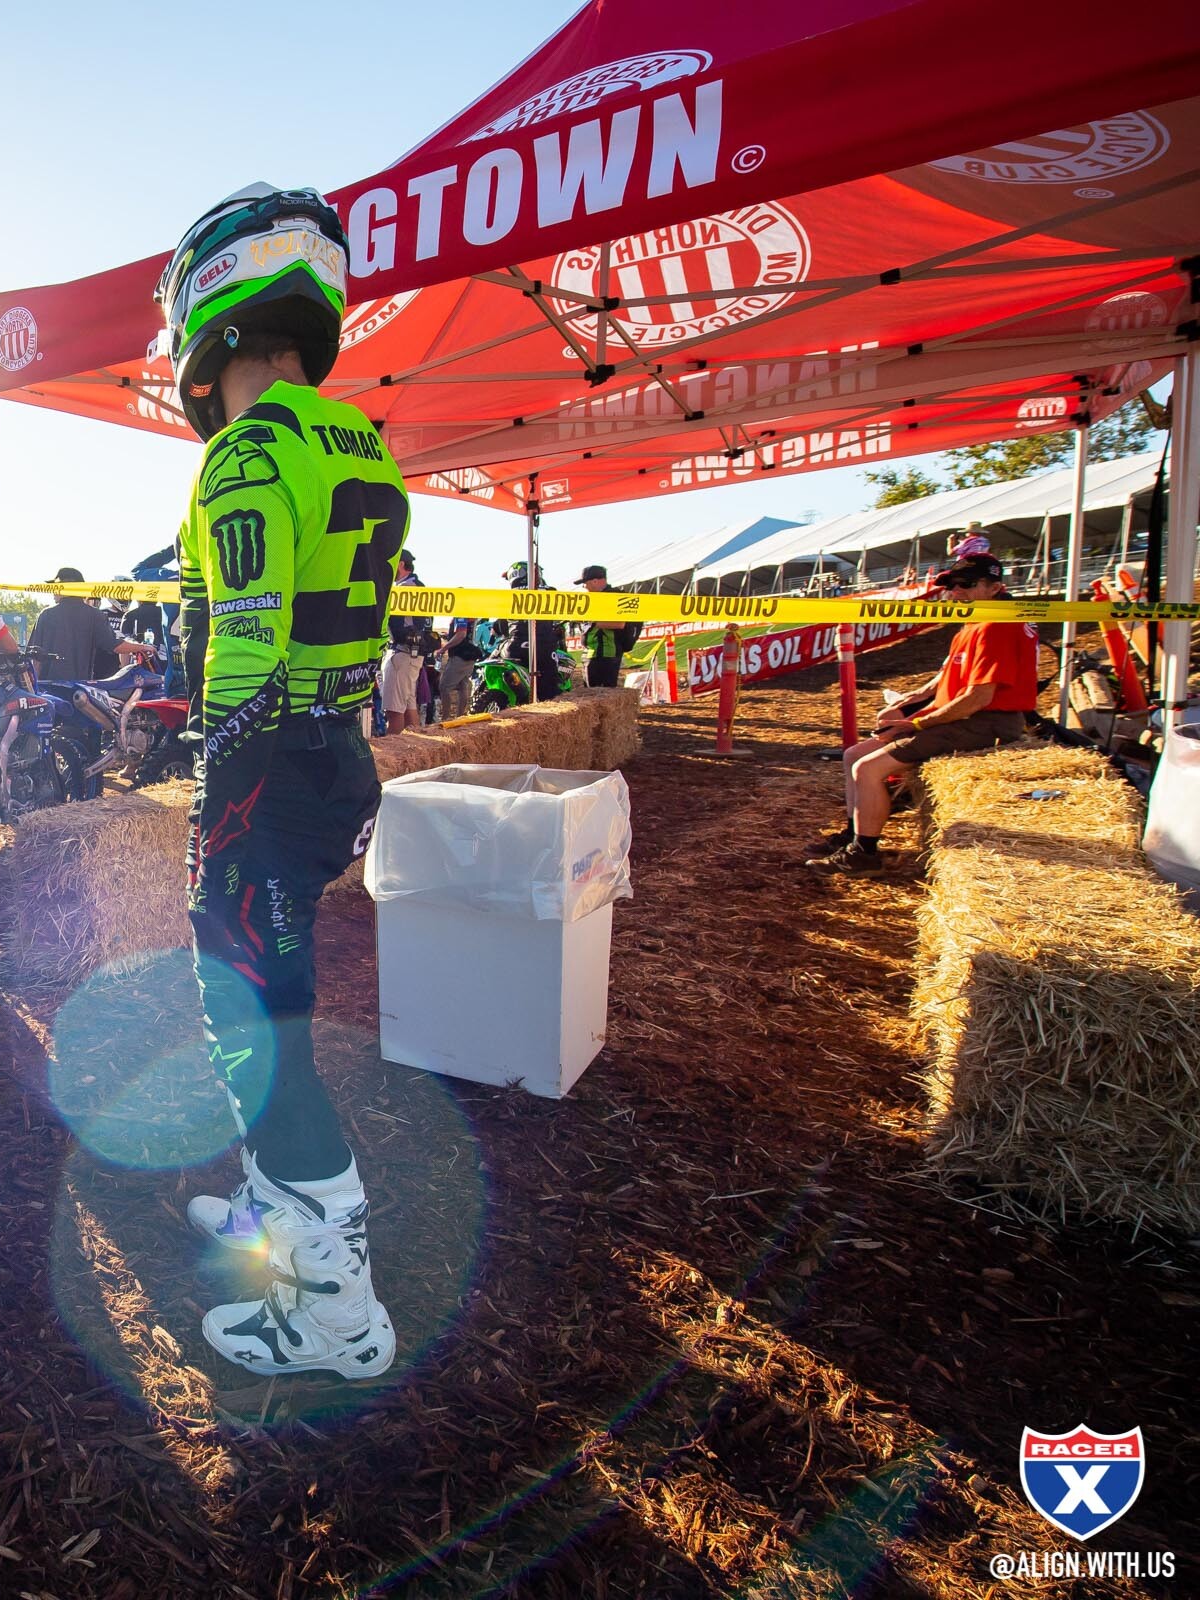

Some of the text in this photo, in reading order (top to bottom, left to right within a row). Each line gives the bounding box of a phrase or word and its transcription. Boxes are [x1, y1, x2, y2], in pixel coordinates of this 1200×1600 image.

[348, 79, 723, 278] GTOWN
[198, 259, 232, 289] BELL
[310, 425, 383, 462] TOMAC
[290, 477, 409, 647] 3
[511, 593, 590, 616] CAUTION
[680, 596, 778, 617] CUIDADO
[689, 647, 762, 686] LUAS
[768, 632, 801, 669] OIL
